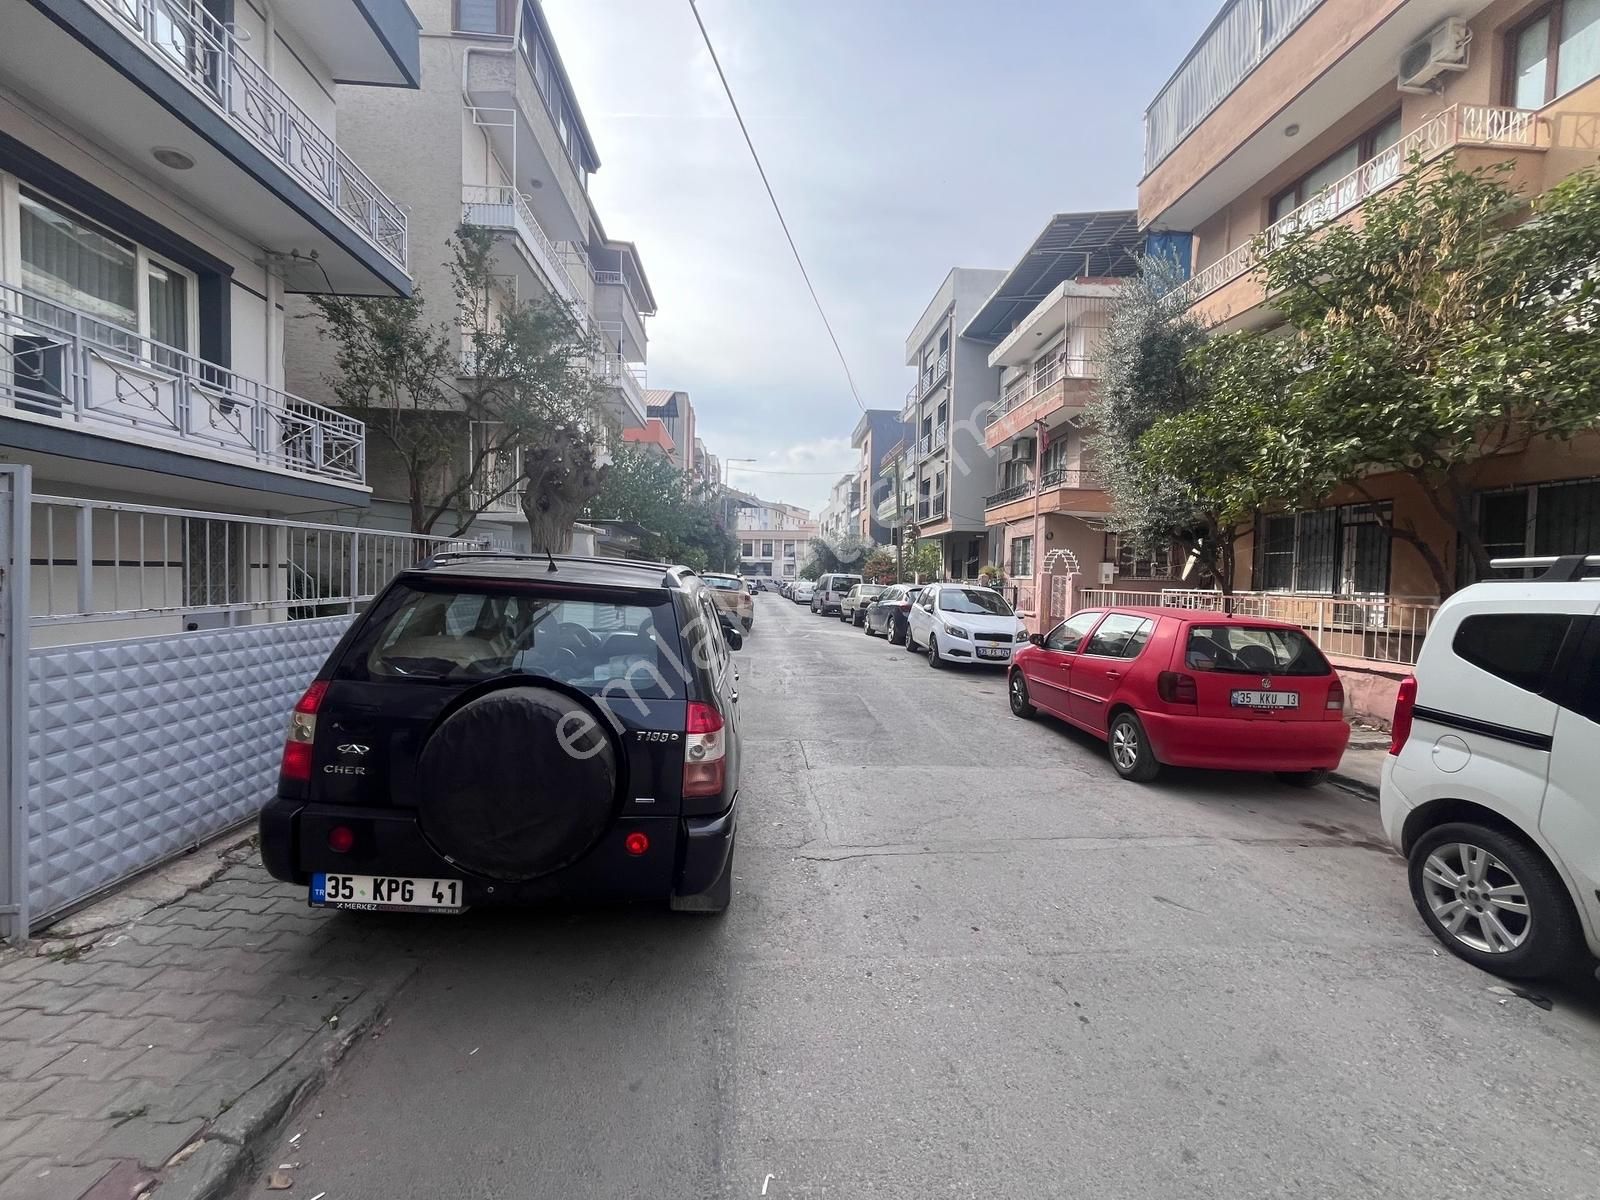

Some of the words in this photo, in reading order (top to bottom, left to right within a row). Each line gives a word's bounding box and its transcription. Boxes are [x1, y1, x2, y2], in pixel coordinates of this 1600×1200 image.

[1240, 692, 1252, 703] 35
[1259, 693, 1278, 704] KKU
[1287, 694, 1297, 705] 13
[314, 888, 325, 897] TR
[326, 875, 354, 900] 35
[372, 878, 414, 903] KPG
[431, 881, 457, 905] 41
[344, 902, 377, 911] MERKEZ
